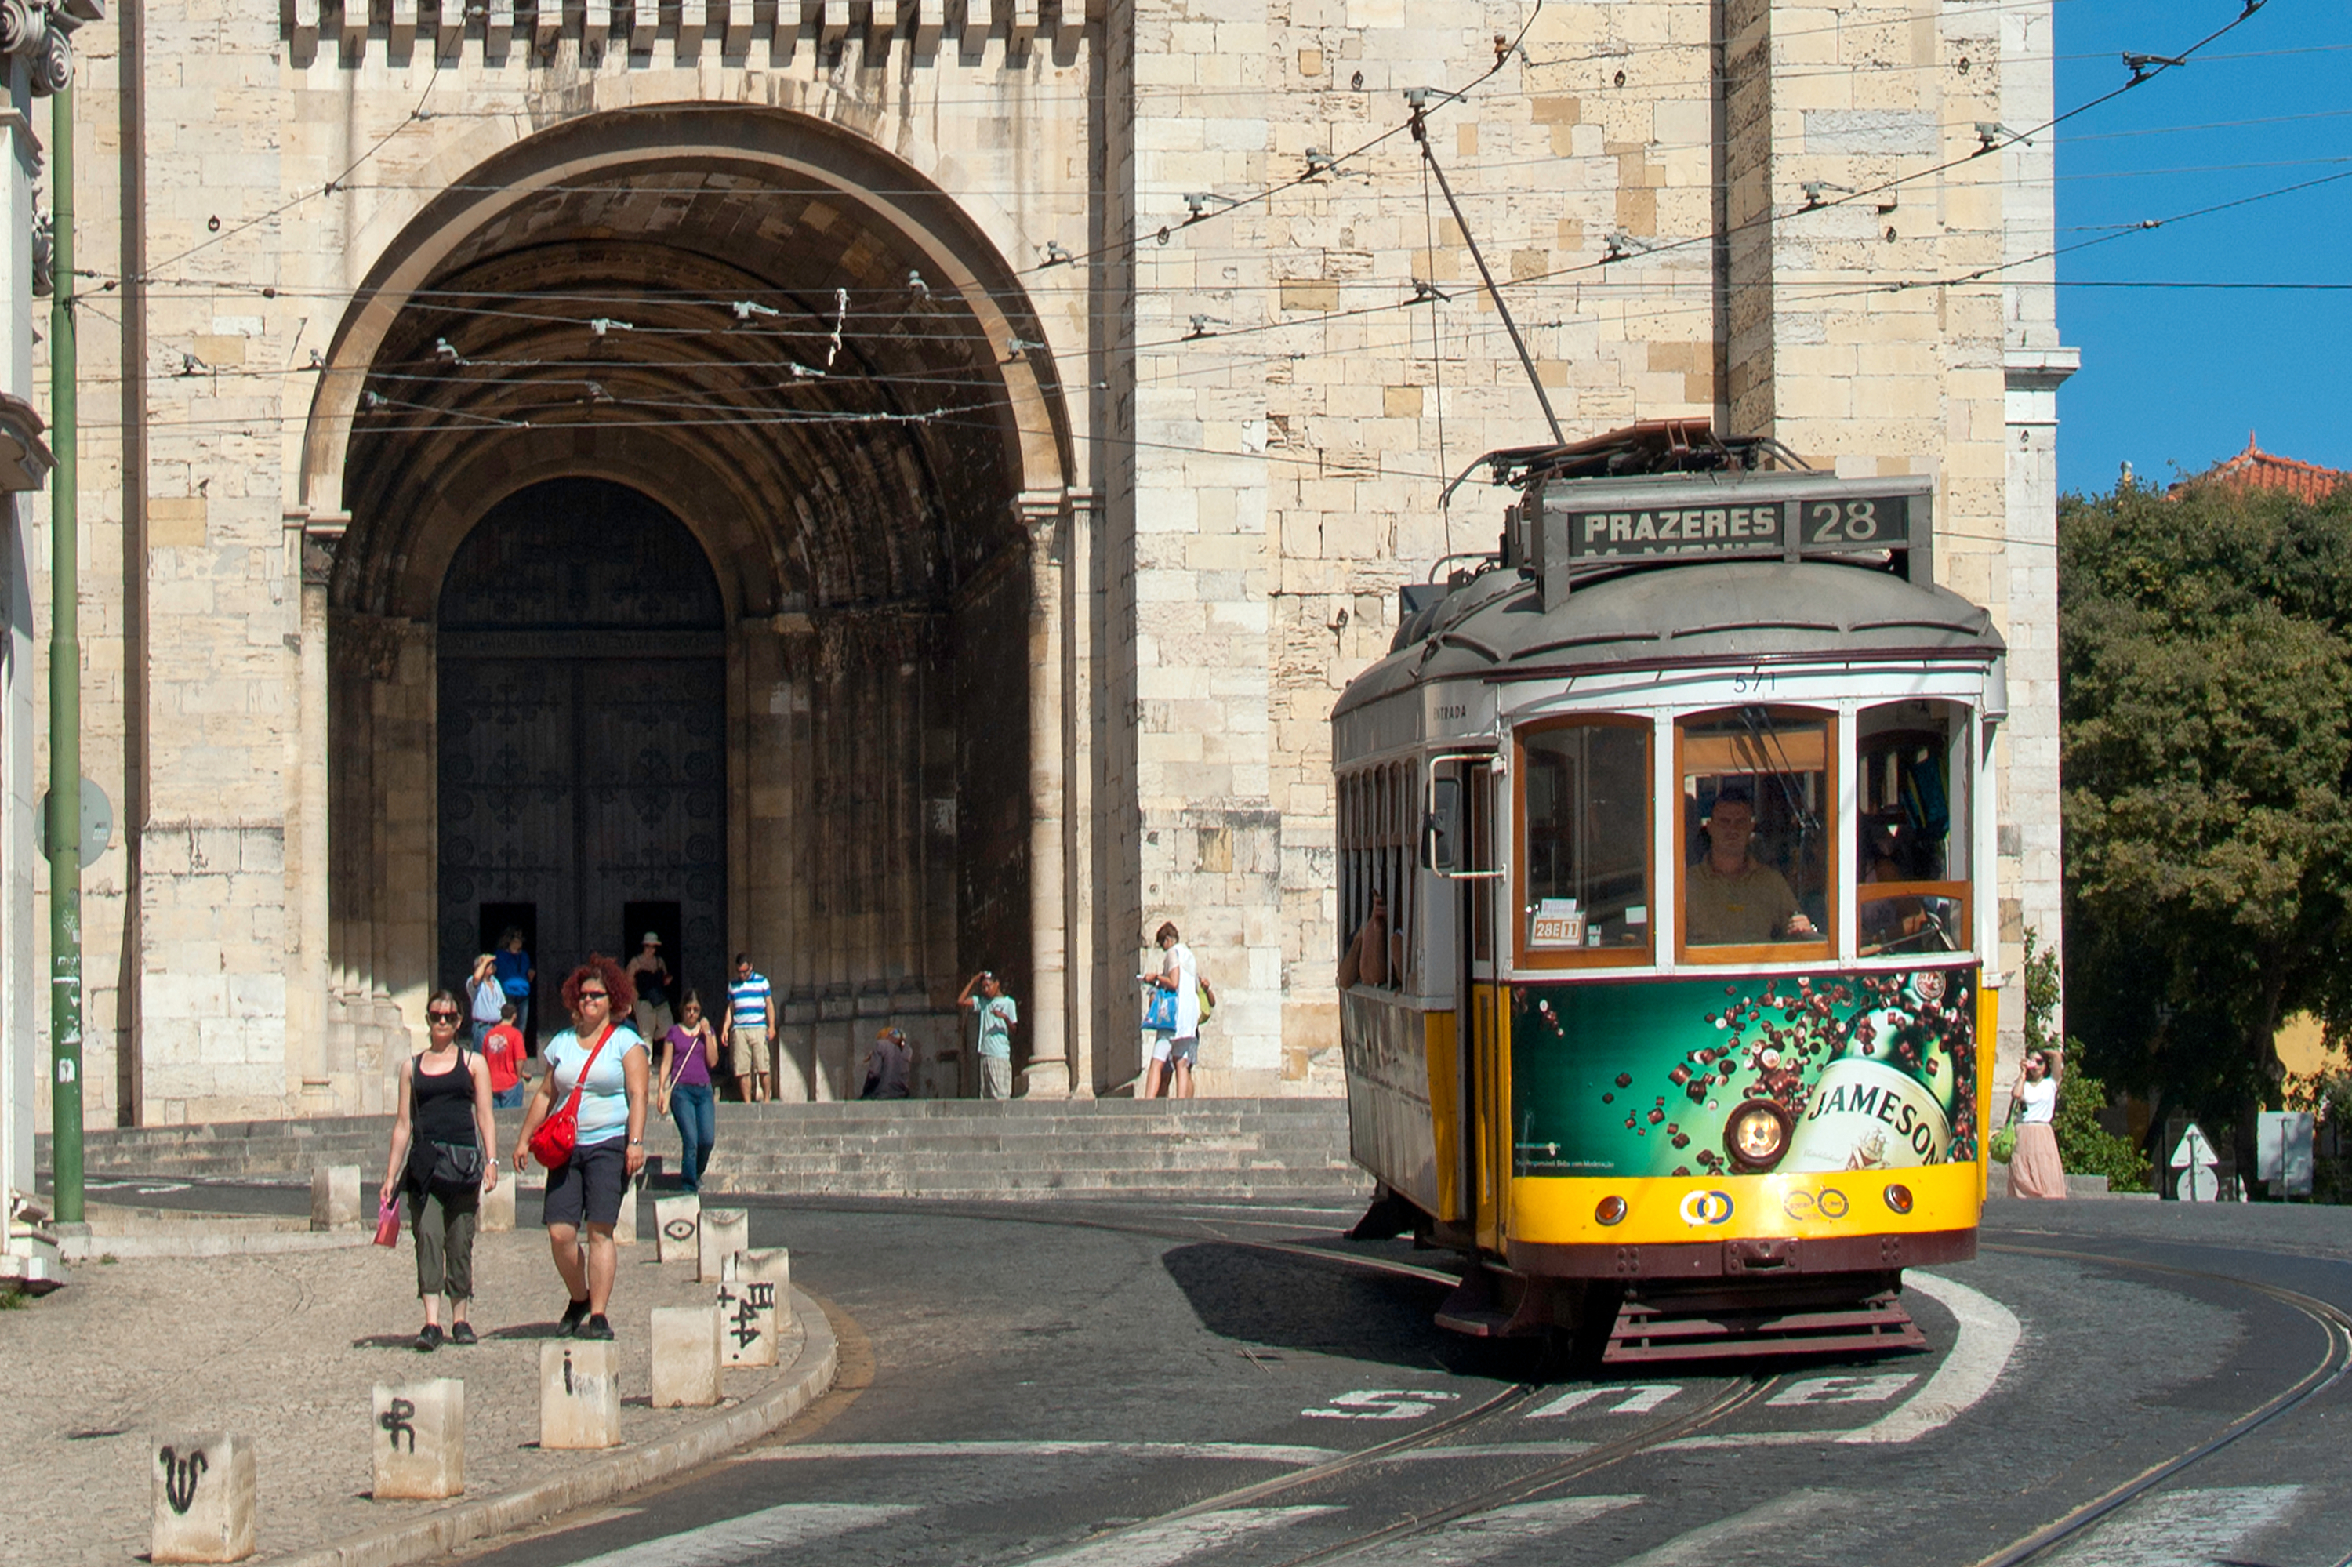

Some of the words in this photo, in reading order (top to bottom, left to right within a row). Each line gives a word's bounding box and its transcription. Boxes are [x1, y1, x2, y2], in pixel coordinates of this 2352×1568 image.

[1584, 507, 1776, 543] PRAZERES
[1813, 499, 1878, 543] 28
[1733, 672, 1776, 694] 571
[1536, 922, 1561, 938] 28E
[1563, 921, 1577, 938] 11
